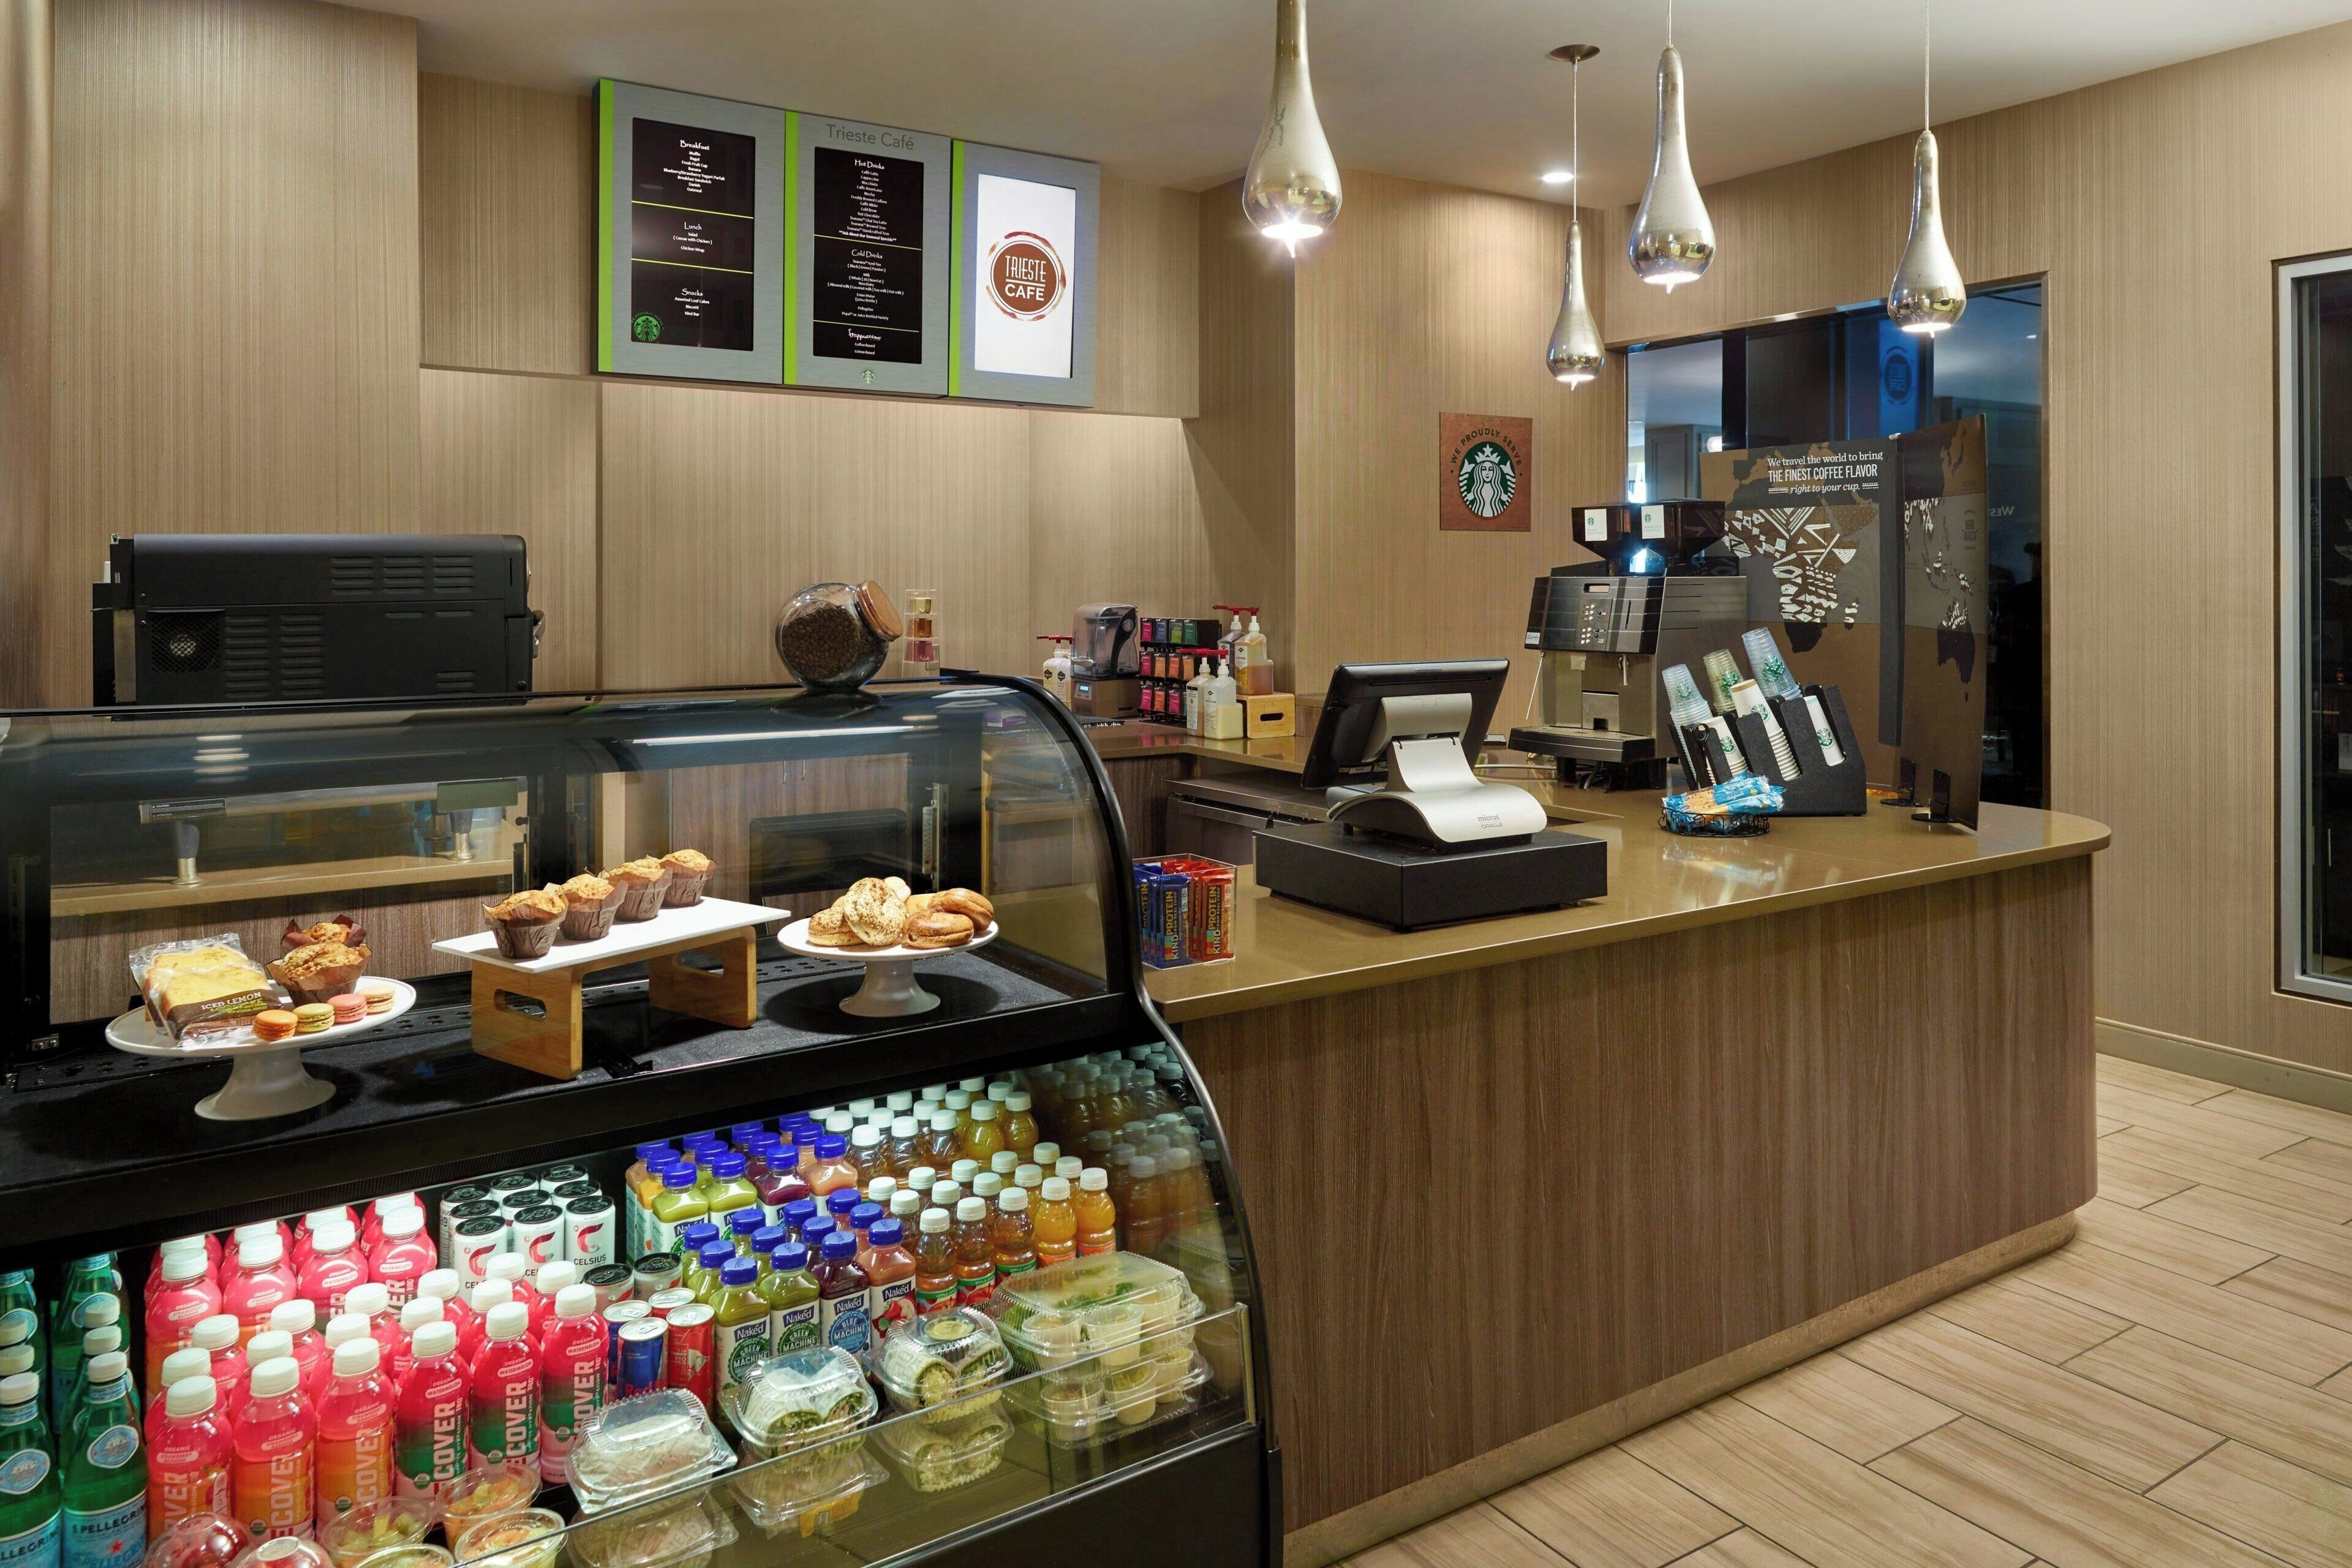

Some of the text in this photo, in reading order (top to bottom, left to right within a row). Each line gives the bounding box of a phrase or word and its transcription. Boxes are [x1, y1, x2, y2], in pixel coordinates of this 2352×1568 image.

[826, 124, 913, 149] Trieste Café
[680, 140, 709, 151] Breakfast
[867, 161, 884, 170] Drinks
[684, 222, 701, 230] Lunch
[1005, 255, 1046, 282] TRIESTE
[1005, 284, 1044, 301] CAFE
[1450, 428, 1522, 466] WE PROUDLY SERVE
[1767, 458, 1781, 467] We
[1782, 456, 1806, 466] travel
[1807, 455, 1821, 464] the
[1822, 453, 1847, 462] world
[1859, 451, 1883, 461] bring
[1768, 464, 1877, 483] THE FINEST COFFEE FLAVOR
[1790, 485, 1810, 495] right
[1822, 484, 1841, 494] your
[1843, 483, 1860, 492] cup.
[227, 992, 261, 1005] LEMON
[574, 1254, 606, 1265] CELSIUS
[323, 1273, 356, 1285] WATERMELON
[329, 1268, 351, 1277] ORGANIC
[970, 1300, 990, 1312] Tropic
[842, 1318, 858, 1328] BLUE
[790, 1329, 809, 1341] GREEN
[834, 1324, 866, 1340] MACHINE
[573, 1334, 594, 1345] ORGANIC
[783, 1338, 817, 1352] MACHINE
[568, 1340, 600, 1354] WATERMELON
[740, 1344, 761, 1357] GREEN
[505, 1354, 527, 1366] ORGANIC
[734, 1352, 767, 1368] MACHINE
[499, 1360, 532, 1375] WATERMELON
[432, 1373, 455, 1387] ORGANIC
[428, 1382, 460, 1396] WATERMELON
[574, 1360, 594, 1433] COVER
[354, 1401, 380, 1413] ORGANIC
[506, 1381, 527, 1457] COVER
[269, 1428, 296, 1440] ORGANIC
[434, 1401, 456, 1480] COVER
[356, 1426, 379, 1503] COVER
